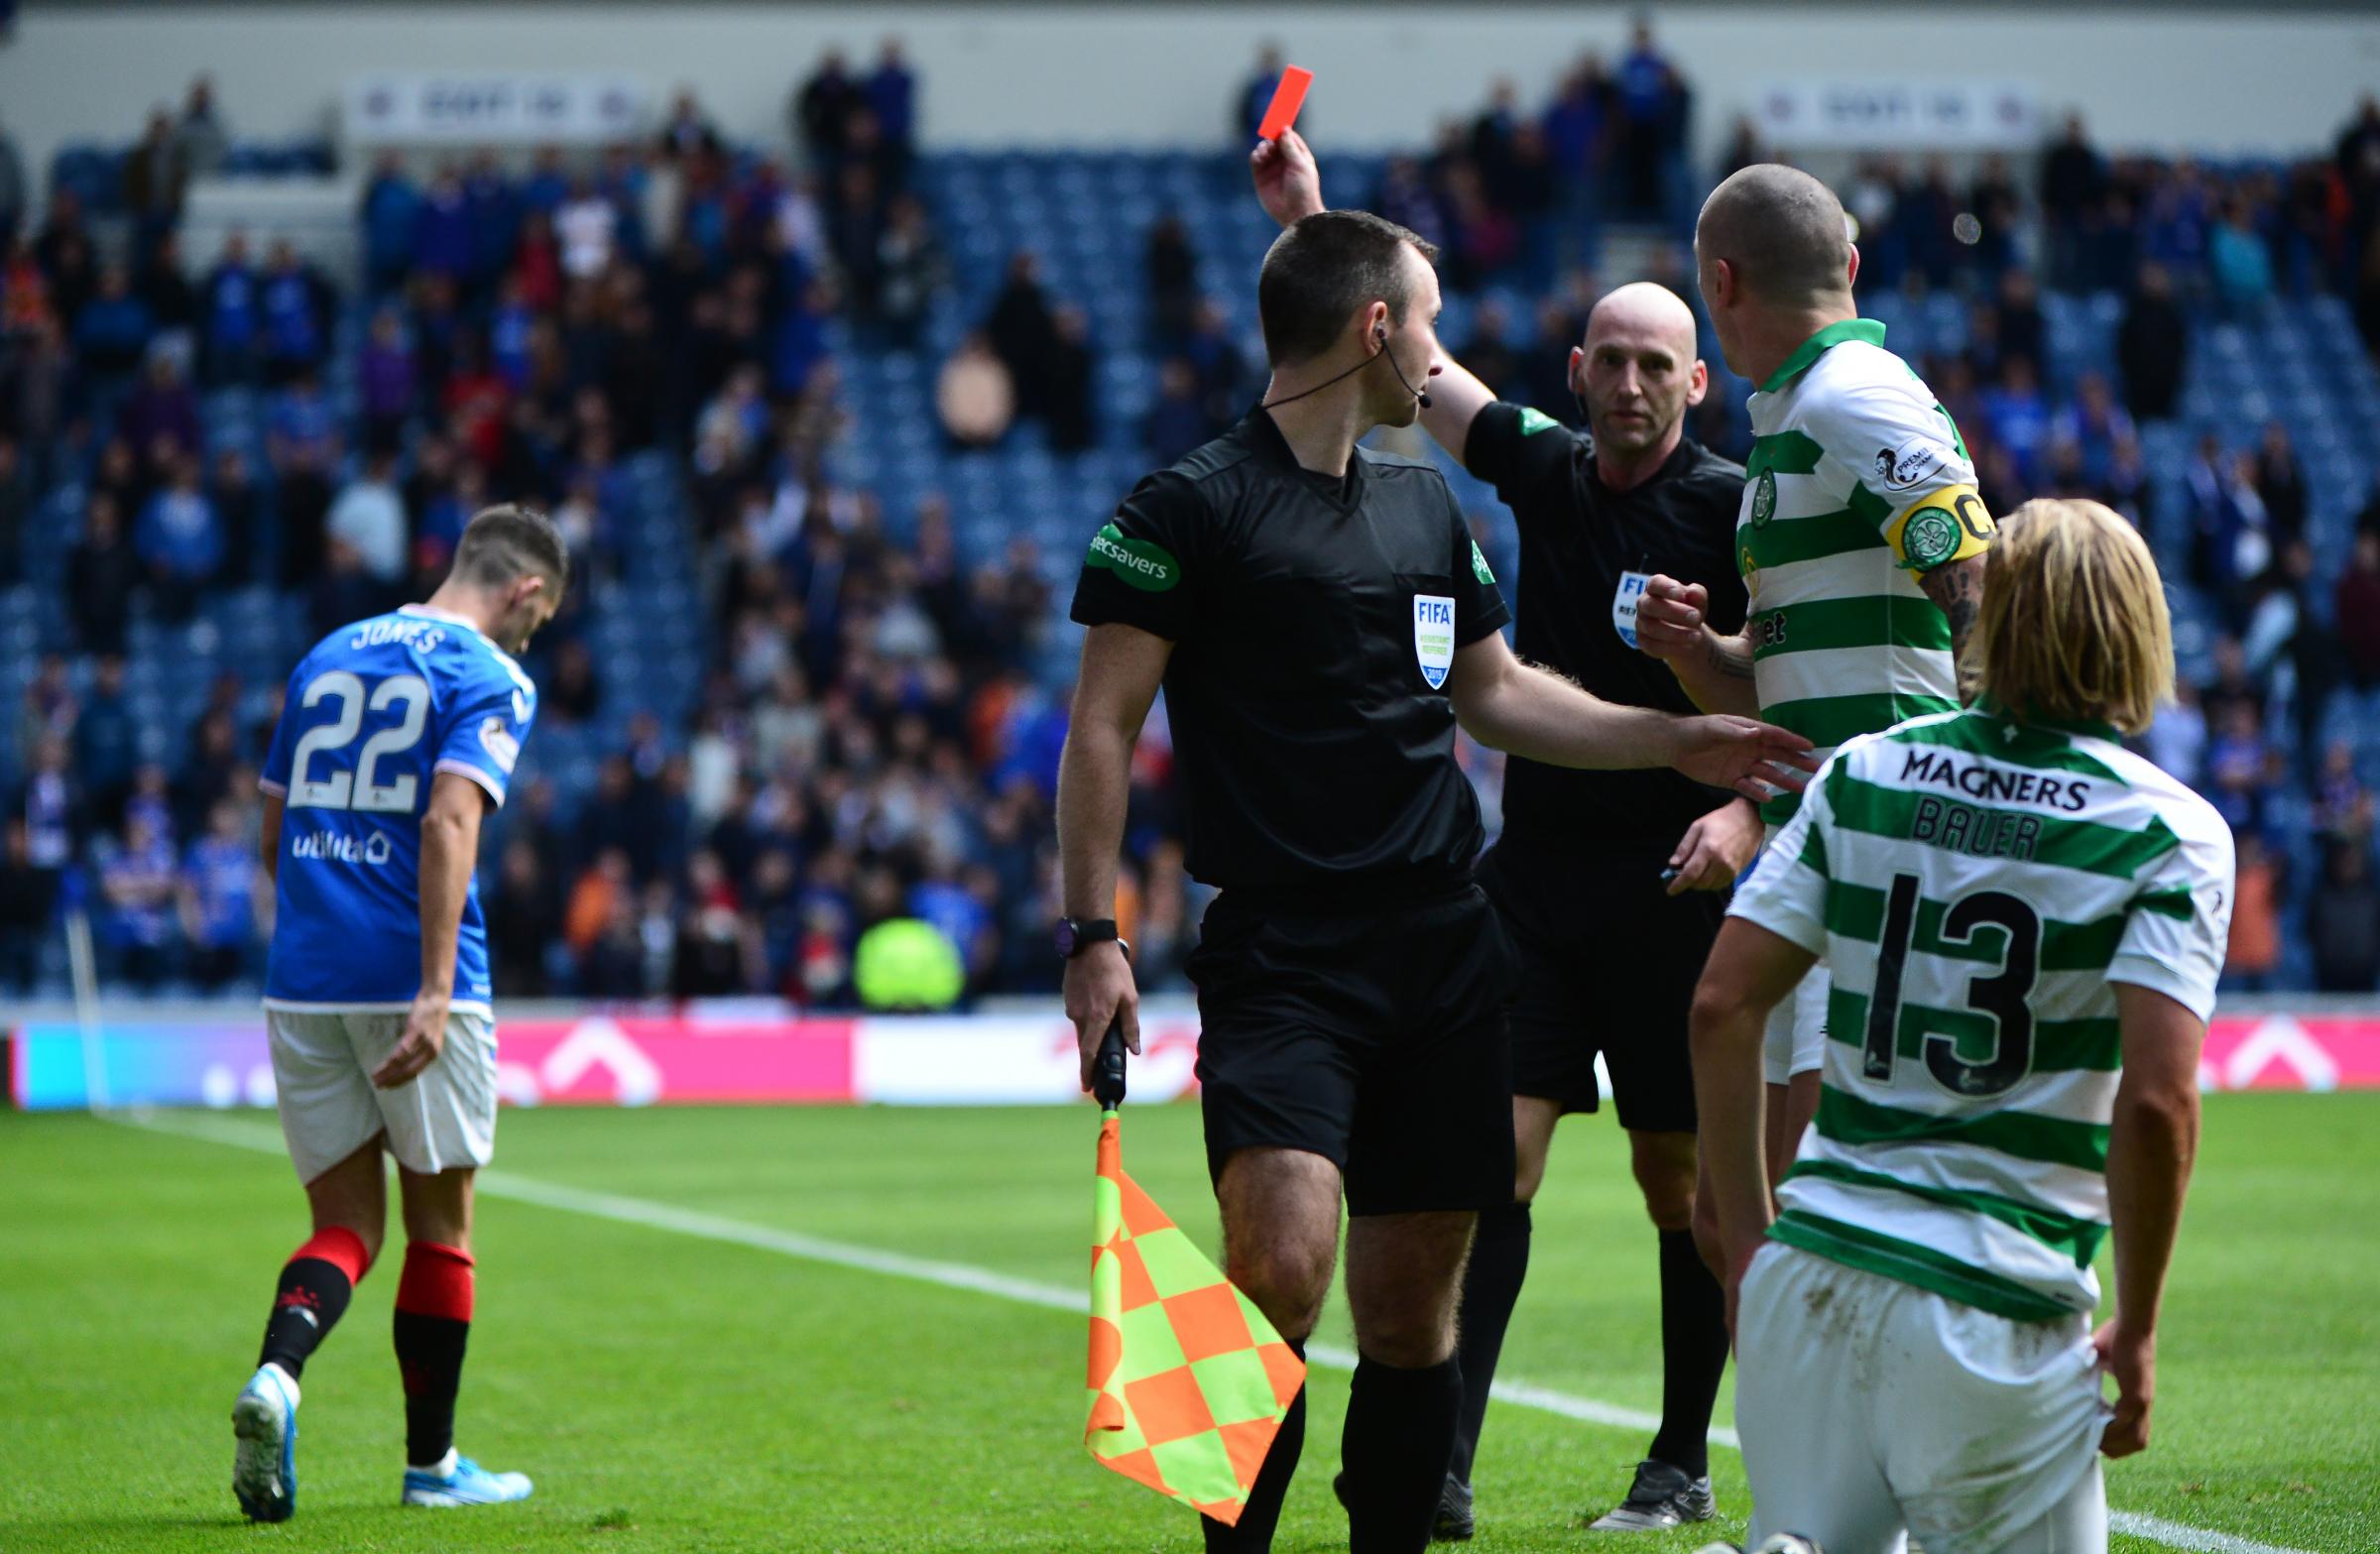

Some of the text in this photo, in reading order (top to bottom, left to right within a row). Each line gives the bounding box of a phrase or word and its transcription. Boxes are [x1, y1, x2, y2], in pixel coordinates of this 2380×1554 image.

[1954, 494, 1995, 540] C
[1623, 577, 1645, 596] FI
[350, 621, 446, 656] JONES
[1418, 602, 1451, 625] FIFA
[287, 670, 430, 813] 22
[1900, 751, 2090, 811] MAGNERS
[1912, 796, 2042, 861] BAUER
[1862, 870, 2042, 1098] 13
